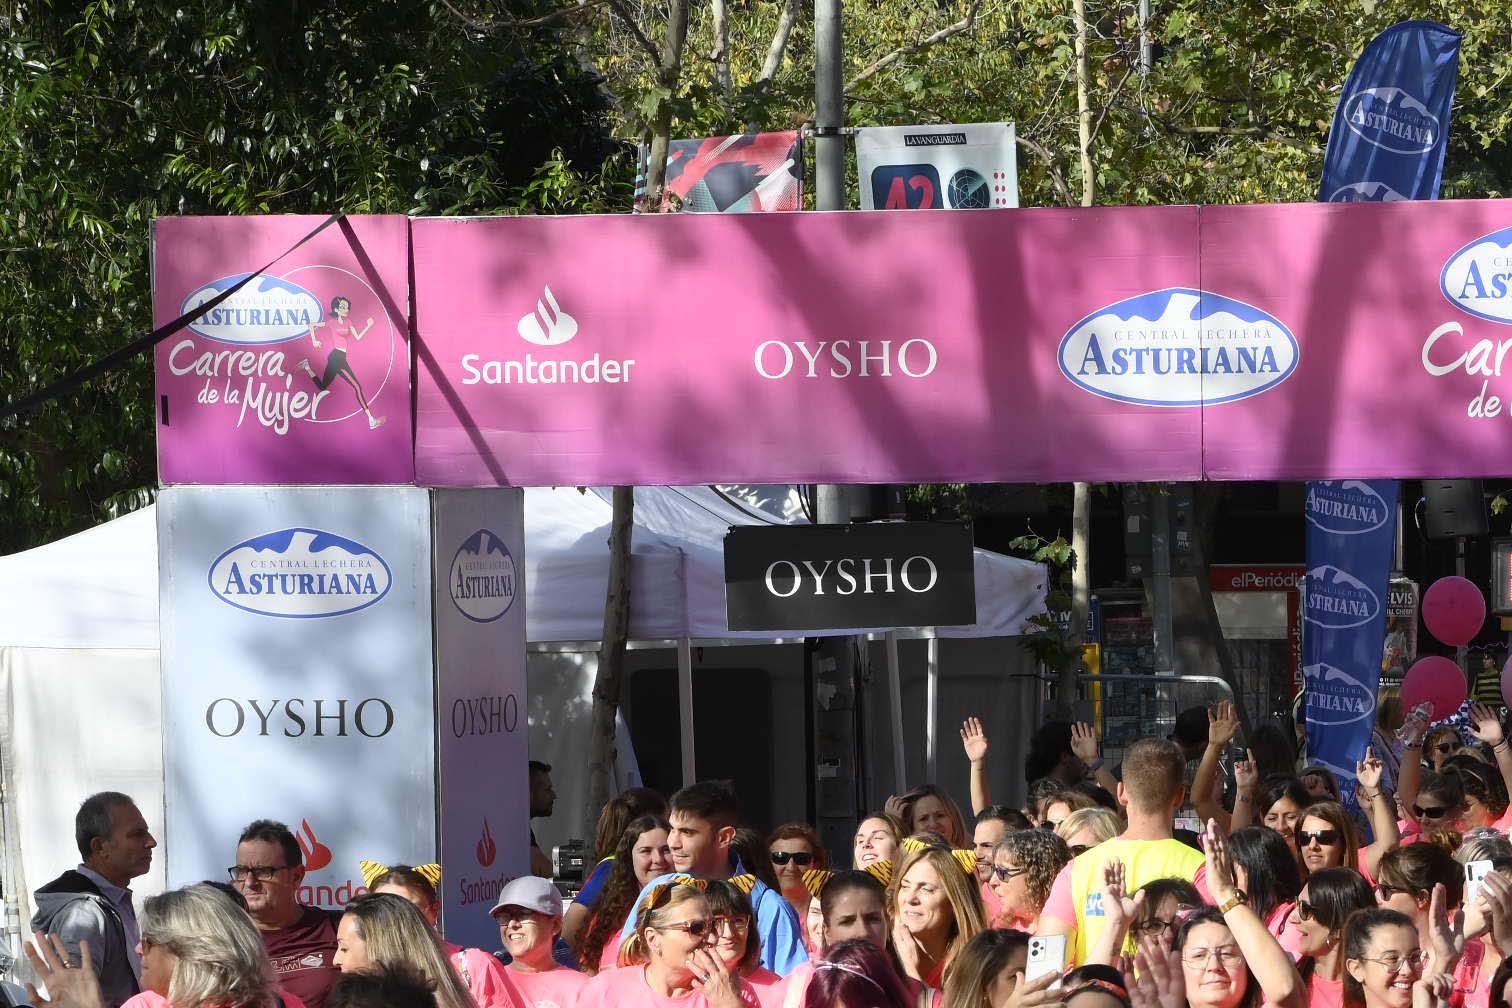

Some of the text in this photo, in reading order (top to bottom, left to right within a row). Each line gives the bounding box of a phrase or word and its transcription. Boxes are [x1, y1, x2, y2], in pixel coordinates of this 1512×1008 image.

[1350, 100, 1433, 145] ASTURIANA
[168, 339, 286, 377] Carrera
[460, 352, 636, 385] Santander
[753, 337, 938, 380] OYSHO
[1077, 332, 1281, 377] ASTURIANA
[197, 374, 331, 435] de la Mujer
[1467, 379, 1503, 418] de
[222, 561, 379, 597] ASTURIANA
[455, 564, 513, 600] ASTURIANA
[764, 555, 938, 598] OYSHO
[1231, 571, 1298, 588] elPeriódi
[205, 696, 395, 739] OYSHO
[452, 694, 518, 739] OYSHO
